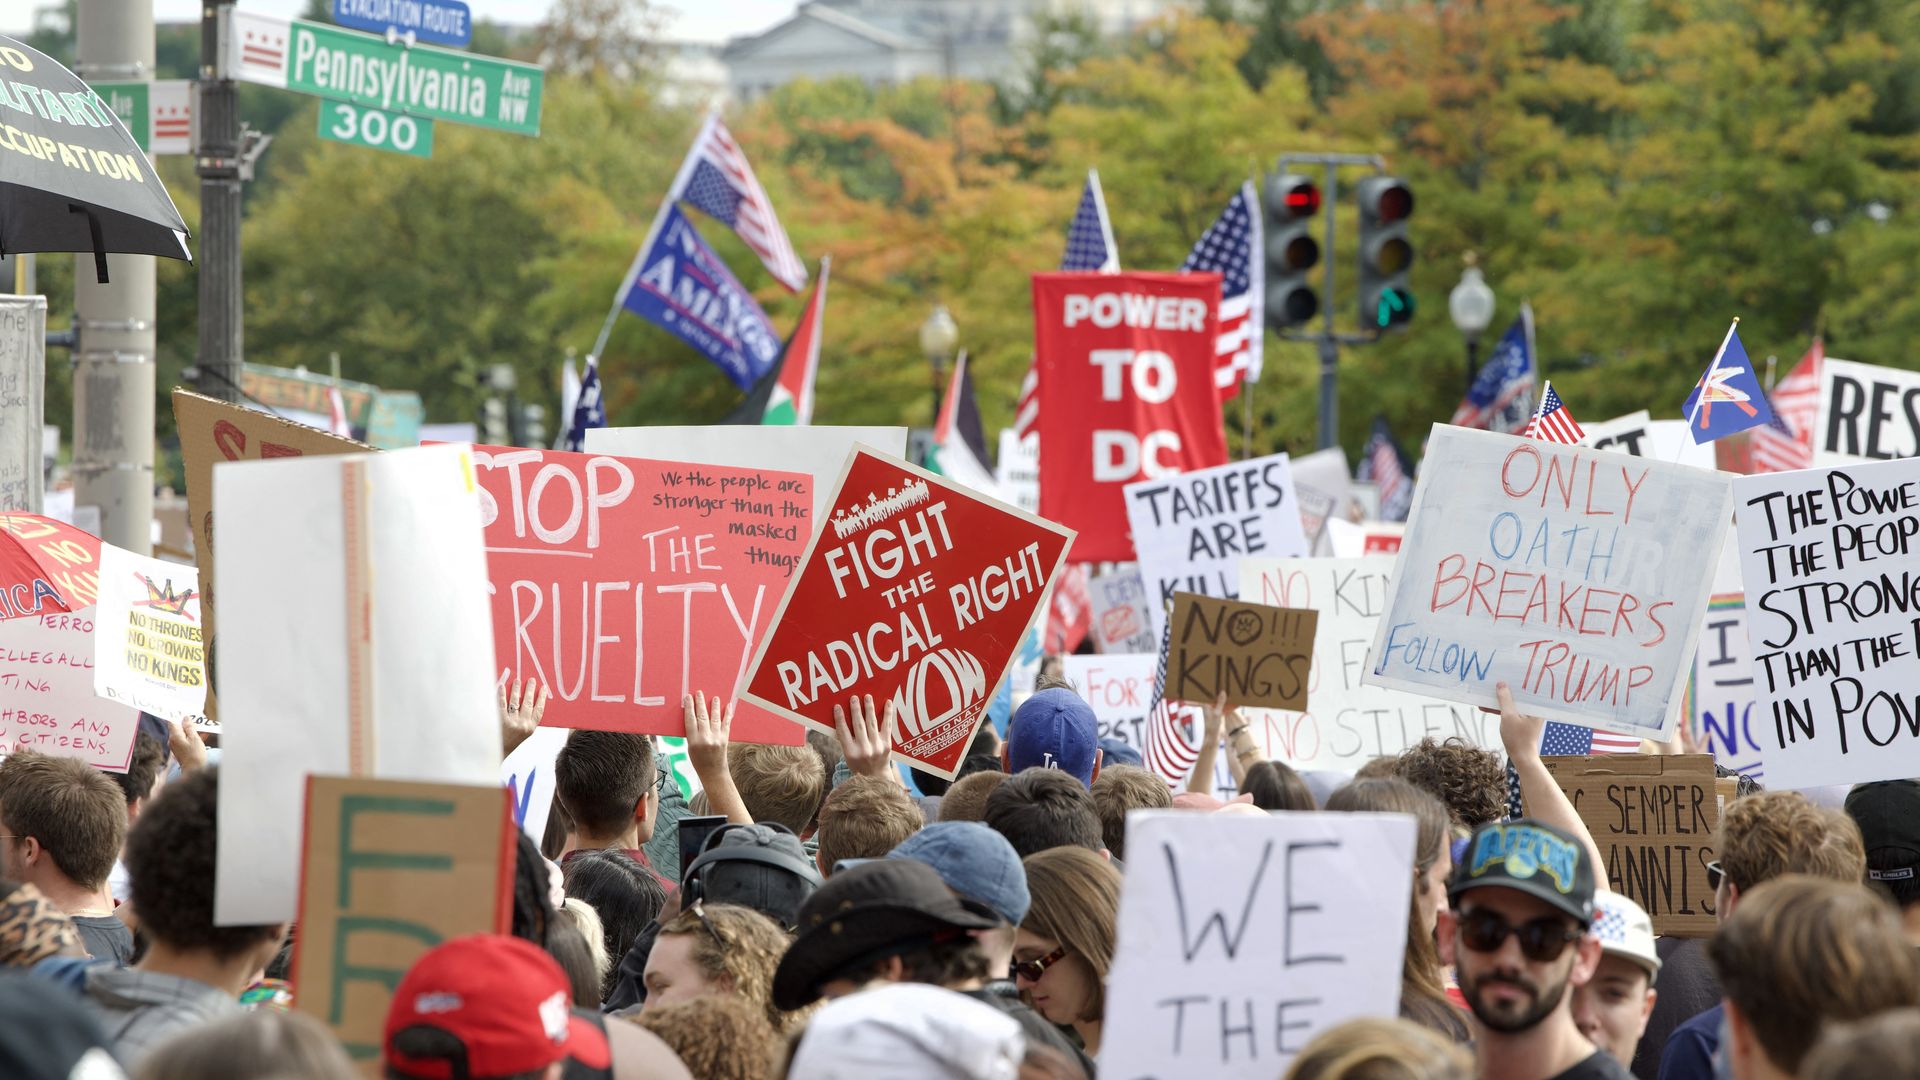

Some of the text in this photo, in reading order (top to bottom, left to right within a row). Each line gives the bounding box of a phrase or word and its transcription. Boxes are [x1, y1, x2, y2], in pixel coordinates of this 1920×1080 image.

[423, 4, 466, 37] ROUTE
[295, 29, 531, 118] Pennsylvania Ave
[0, 79, 112, 128] LITARY
[332, 104, 418, 150] 300
[498, 97, 529, 124] NW
[1063, 293, 1208, 332] POWER
[1089, 349, 1178, 403] TO
[1092, 430, 1183, 482] DC
[652, 493, 808, 518] stronger than the
[661, 471, 806, 496] We the people are
[1135, 463, 1283, 527] TARIFFS
[1501, 443, 1650, 525] ONLY
[728, 521, 797, 541] masked
[1188, 515, 1267, 562] ARE
[1747, 490, 1833, 541] THE
[38, 540, 93, 569] NO
[642, 525, 722, 573] THE
[744, 546, 802, 577] thugs
[824, 501, 954, 599] FIGHT
[1490, 511, 1618, 580] OATH
[1753, 541, 1827, 585] THE
[881, 570, 937, 609] THE
[1263, 568, 1311, 608] NO
[1431, 554, 1674, 648] BREAKERS
[128, 630, 203, 662] NO CROWNS
[129, 611, 203, 643] NO THRONES
[777, 541, 1045, 711] RADICAL RIGHT
[127, 650, 149, 672] NO
[151, 658, 201, 686] KINGS
[1178, 648, 1308, 701] KINGS
[1381, 622, 1497, 682] FOLLOW
[1520, 639, 1654, 707] TRUMP
[1755, 644, 1841, 694] THAN
[1843, 633, 1911, 672] THE
[890, 648, 987, 746] NOW
[1087, 667, 1141, 709] FOR
[71, 717, 110, 738] AND
[903, 705, 981, 752] NATIONAL
[911, 716, 976, 756] ORGANIZATION
[940, 727, 970, 749] WOMEN
[1265, 711, 1320, 760] NO
[1772, 698, 1815, 750] IN
[1606, 784, 1711, 835] SEMPER
[1161, 839, 1347, 968] WE
[1156, 996, 1324, 1064] THE
